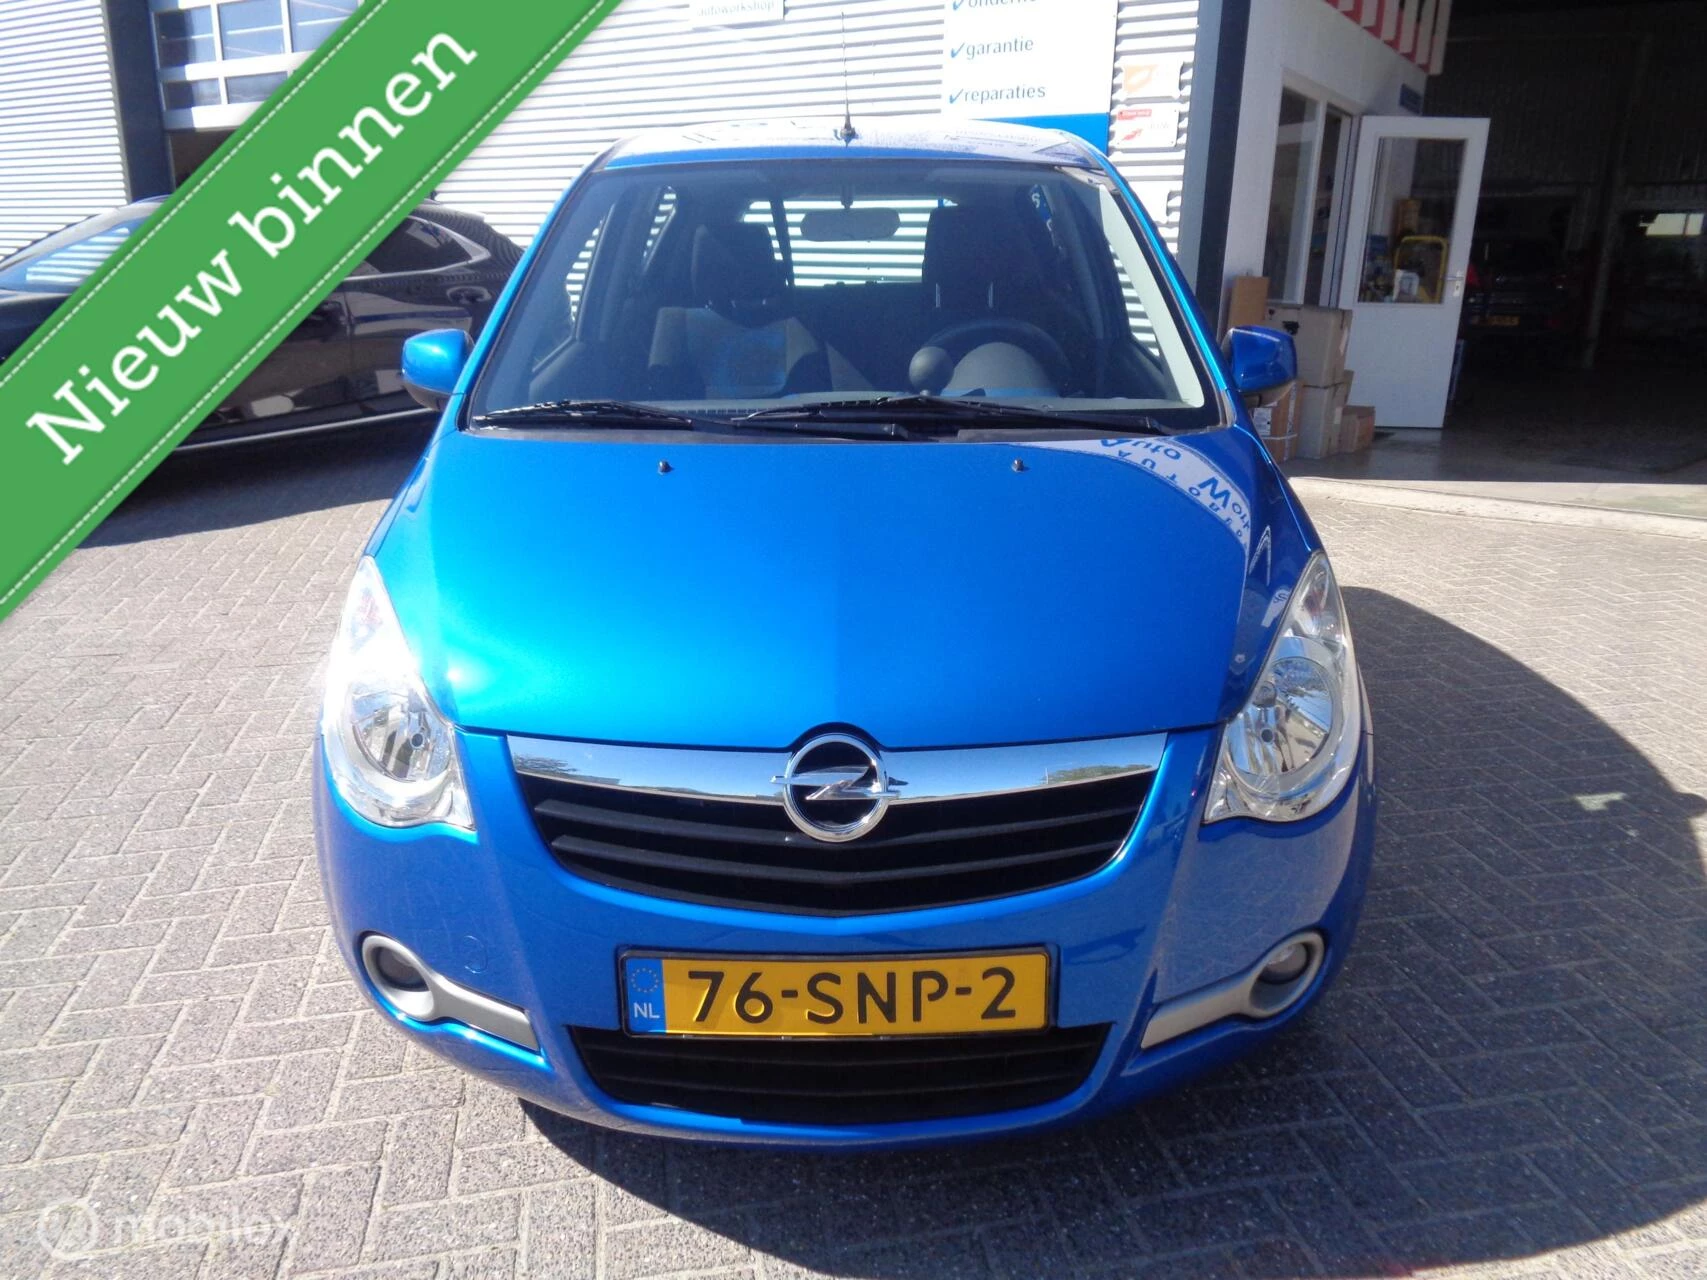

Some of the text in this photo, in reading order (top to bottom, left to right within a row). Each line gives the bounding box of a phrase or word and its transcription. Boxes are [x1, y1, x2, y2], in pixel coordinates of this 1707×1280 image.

[966, 36, 1034, 60] garantie
[964, 84, 1046, 104] reparaties
[688, 966, 1017, 1024] 76-SNP-2
[633, 1001, 660, 1020] NL
